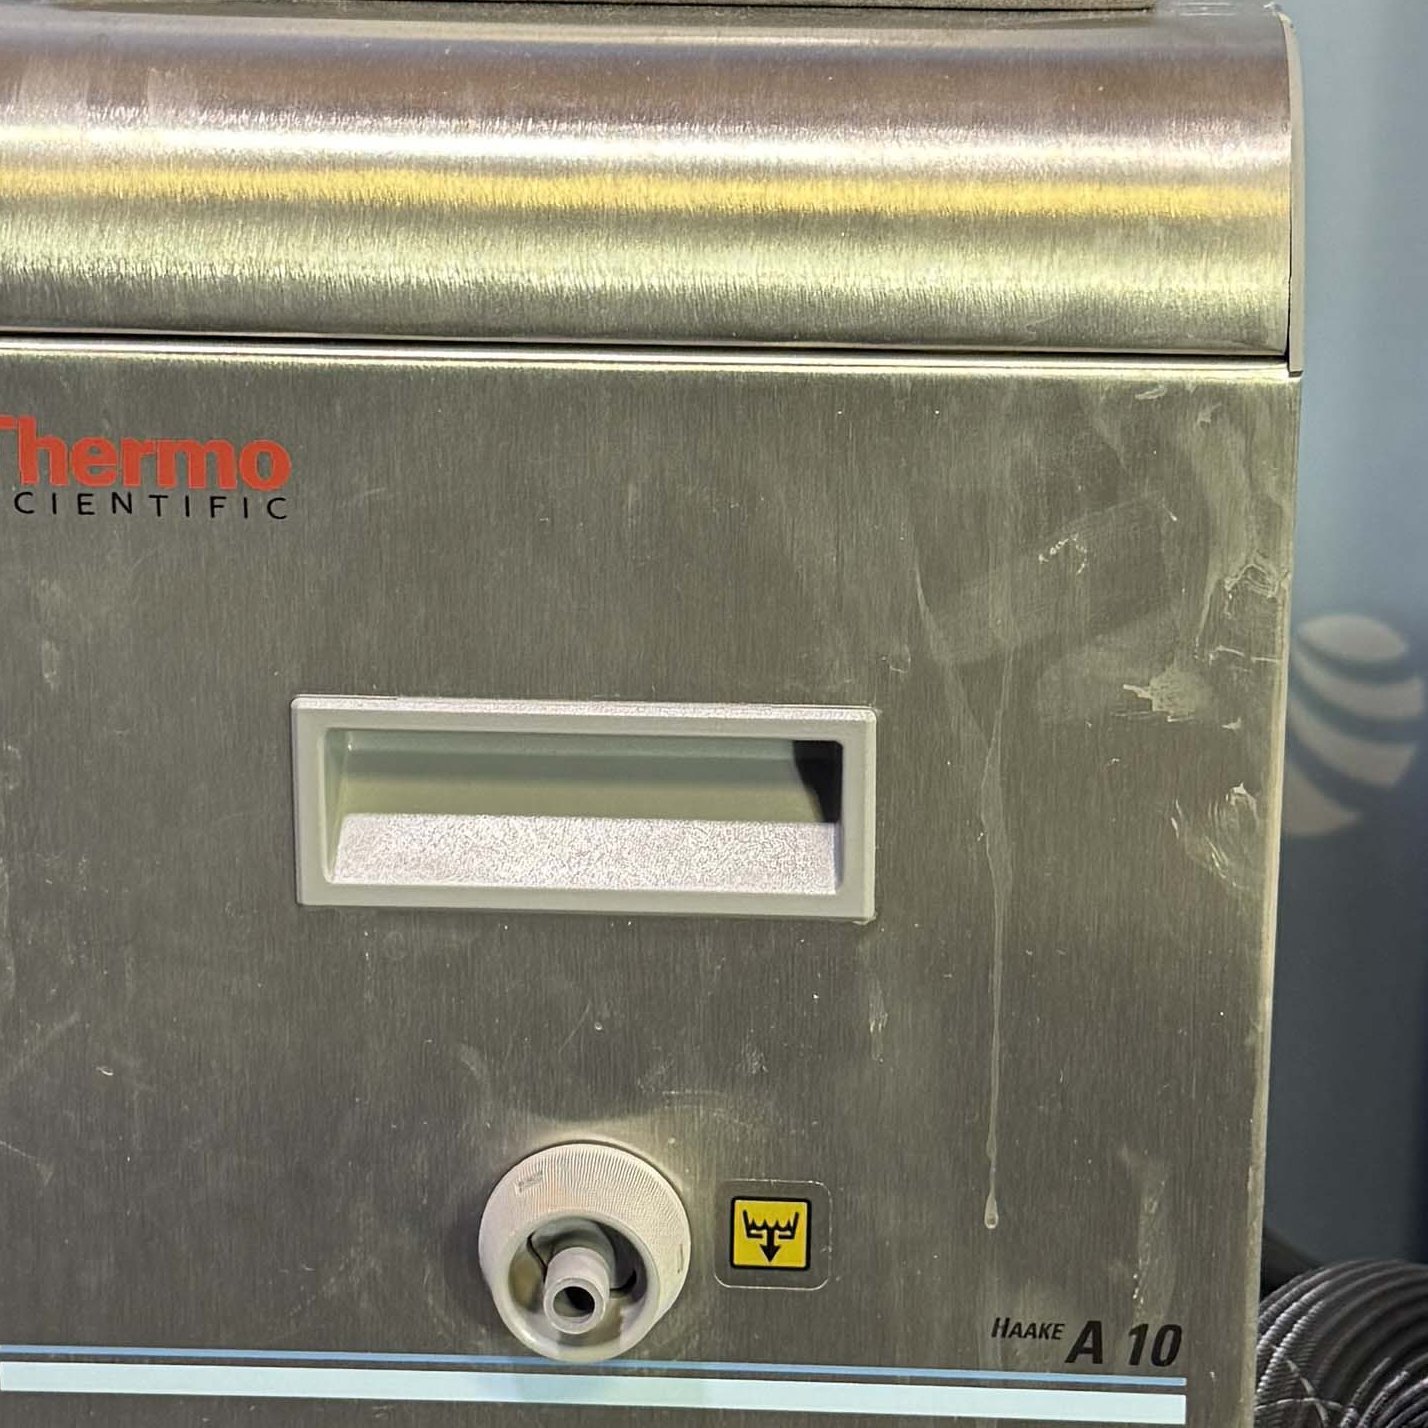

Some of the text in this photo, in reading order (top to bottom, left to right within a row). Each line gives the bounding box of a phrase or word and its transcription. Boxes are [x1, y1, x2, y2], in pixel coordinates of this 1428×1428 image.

[991, 1317, 1183, 1368] HAAKE A 10
